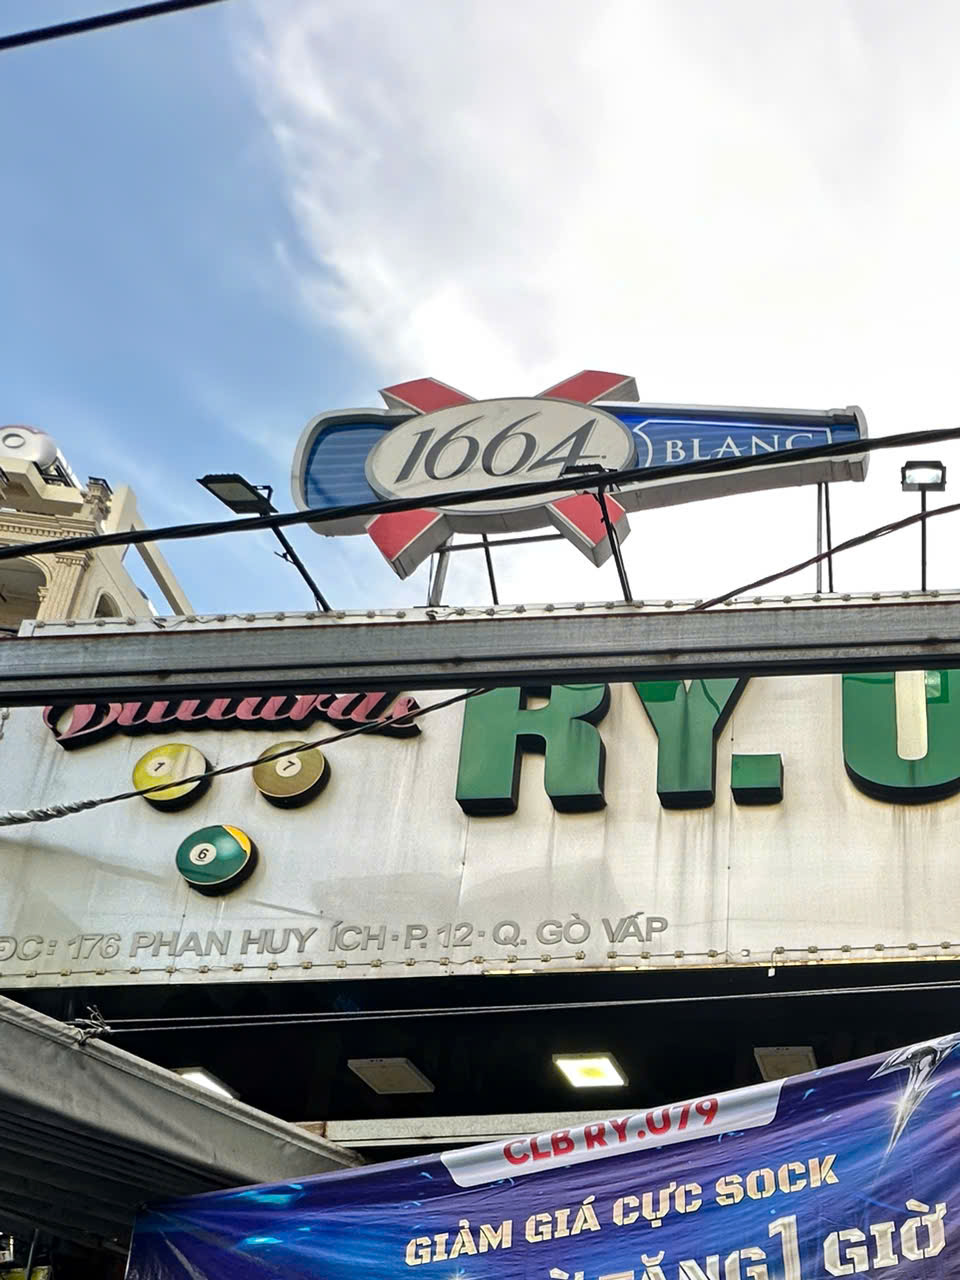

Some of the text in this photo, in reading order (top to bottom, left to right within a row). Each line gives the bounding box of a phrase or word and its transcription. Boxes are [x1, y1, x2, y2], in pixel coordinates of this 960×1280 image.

[394, 412, 607, 484] 1664
[664, 433, 814, 463] BLANC
[67, 932, 121, 960] 176
[129, 929, 232, 958] PHAN
[240, 927, 319, 954] HUY
[536, 913, 591, 945] GÒ
[602, 912, 668, 943] VẤP
[503, 1097, 719, 1166] CLB RY.U79
[404, 1153, 840, 1266] GIẢM GIÁ CỰC SOCK
[823, 1198, 947, 1278] GIỜ
